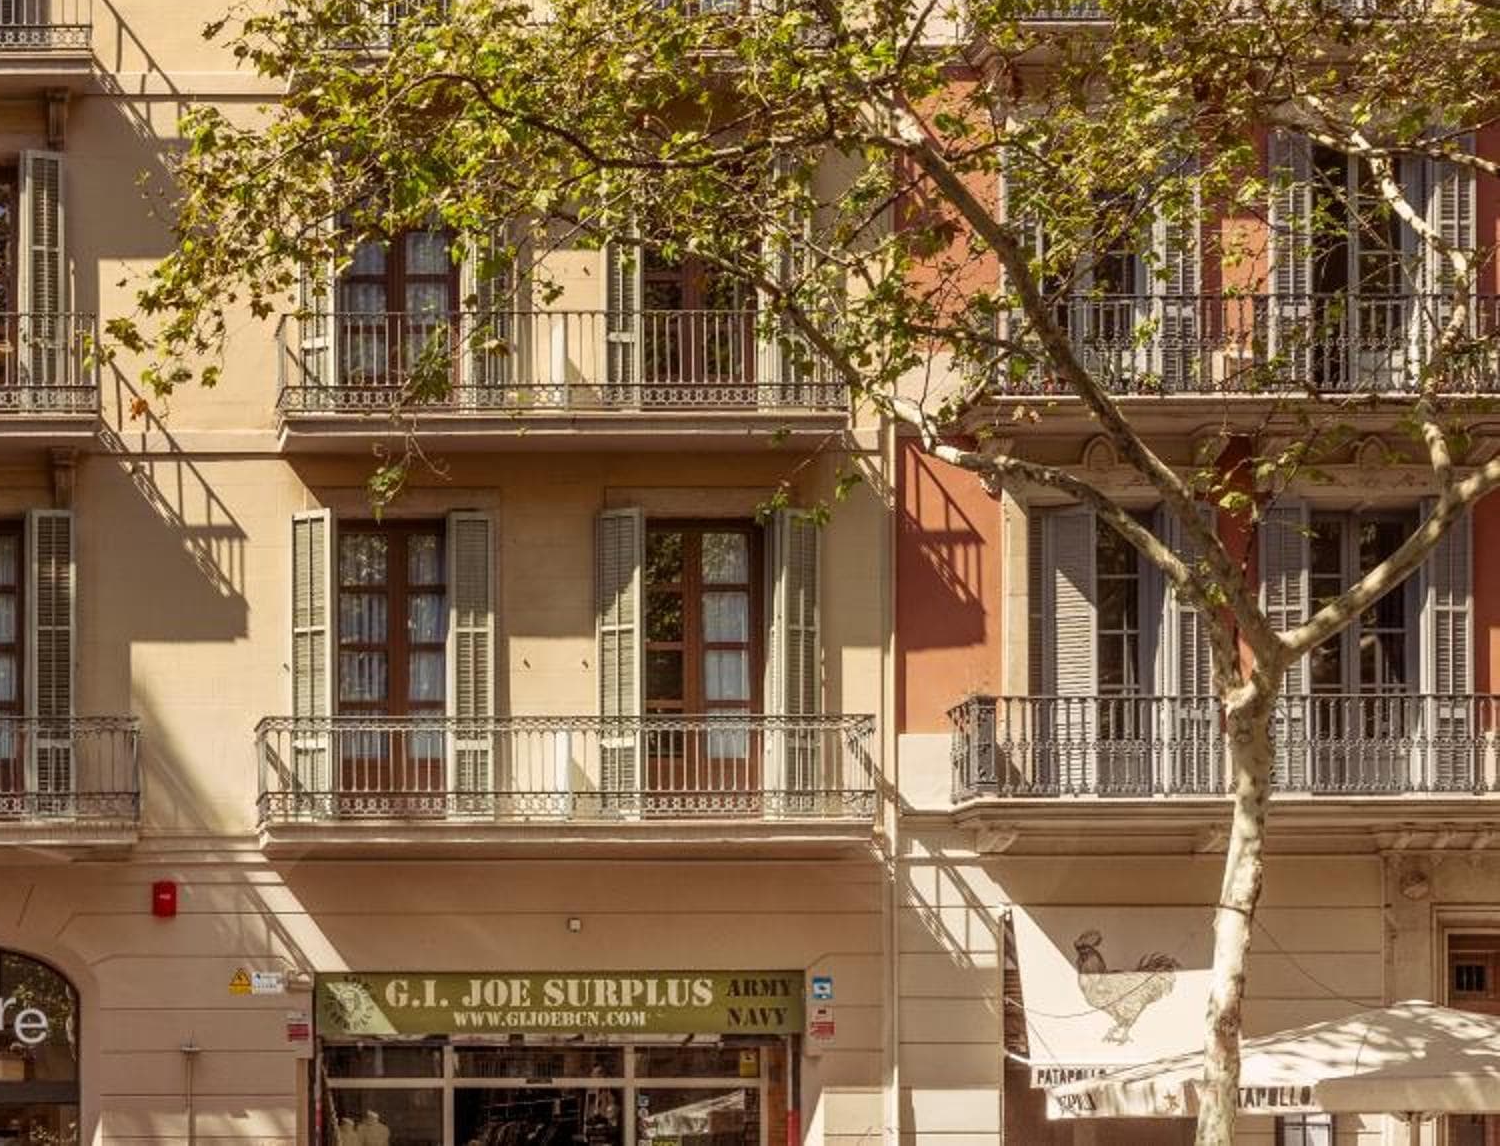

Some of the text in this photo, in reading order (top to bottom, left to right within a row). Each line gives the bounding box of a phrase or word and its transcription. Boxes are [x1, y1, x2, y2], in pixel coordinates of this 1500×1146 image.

[385, 979, 449, 1007] G.I.
[462, 979, 531, 1007] JOE
[543, 979, 714, 1007] SURPLUS
[726, 979, 792, 996] ARMY
[453, 1011, 646, 1027] WWW.GIJOEBCN.COM
[727, 1008, 788, 1026] NAVY
